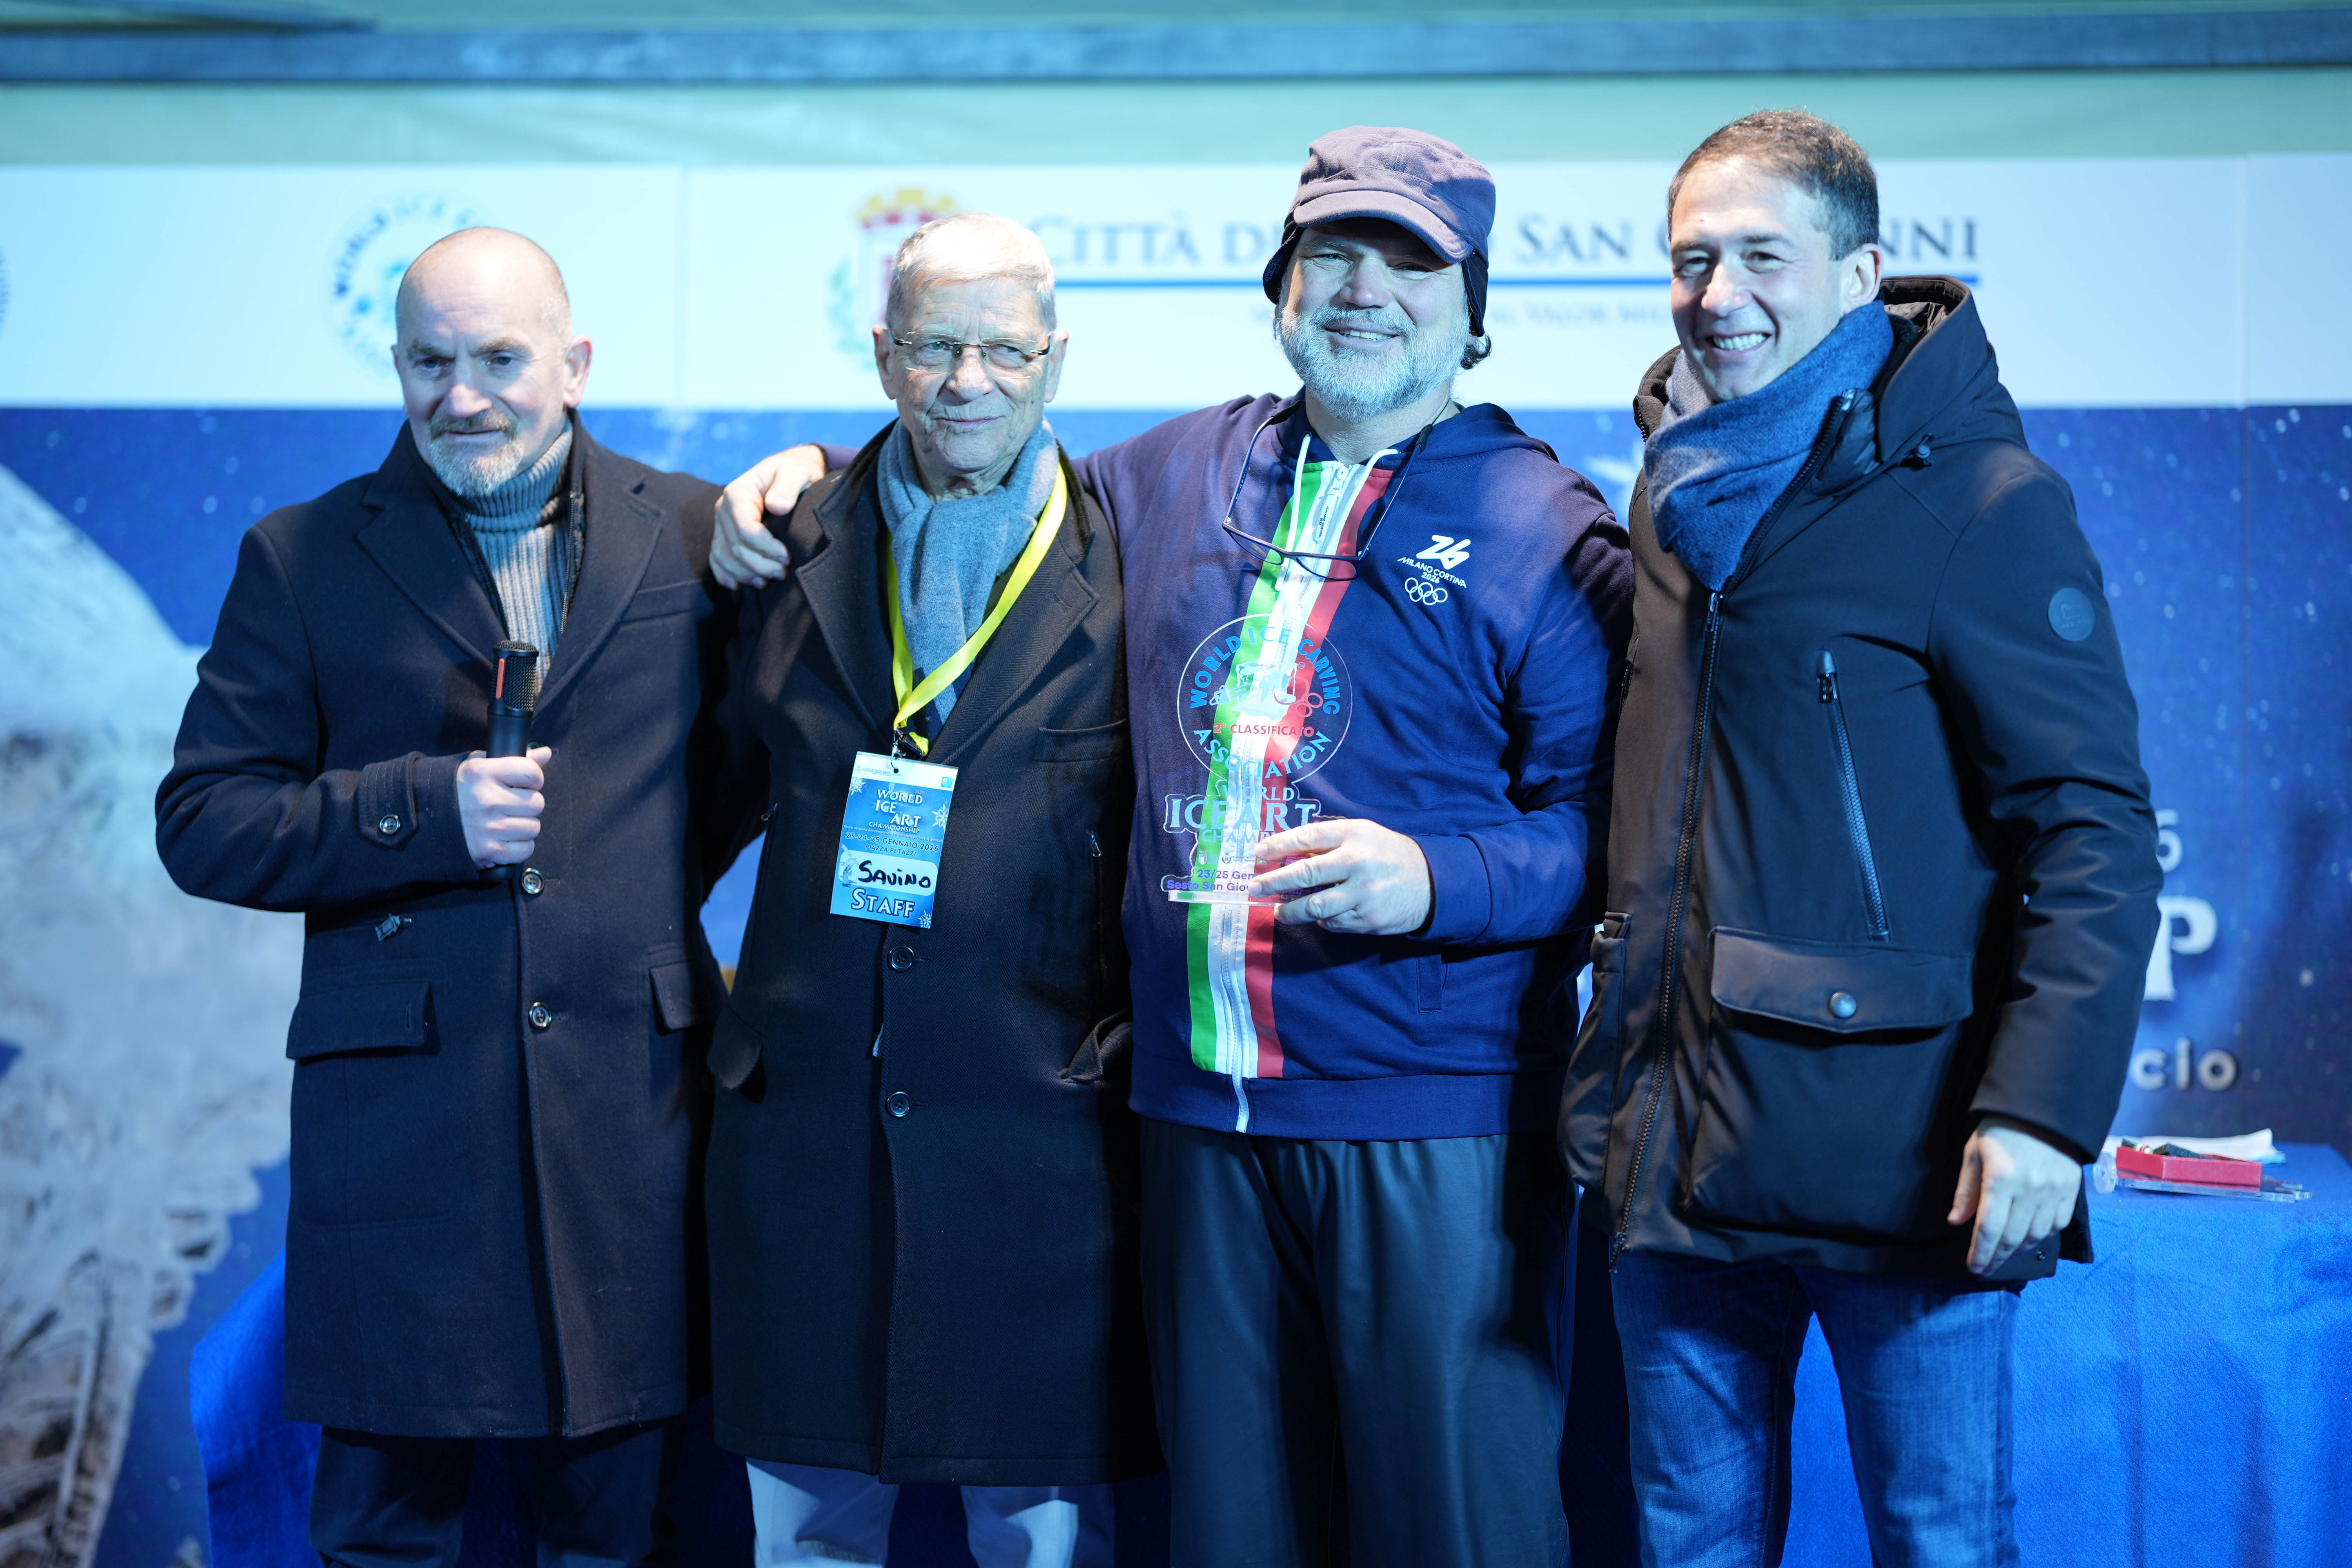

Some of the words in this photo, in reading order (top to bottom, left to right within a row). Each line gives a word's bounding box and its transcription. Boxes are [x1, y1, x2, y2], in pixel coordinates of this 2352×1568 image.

[1515, 215, 1634, 264] SAN
[1397, 557, 1433, 573] MILANO
[1433, 569, 1467, 588] CORTINA
[1421, 572, 1440, 584] 2026
[1190, 636, 1242, 708] WORLD
[1247, 626, 1292, 645] ICE
[1298, 639, 1341, 715] CARVING
[1230, 724, 1314, 737] CLASSIFICATO
[1193, 729, 1332, 779] ASSOCIATION
[877, 789, 923, 804] WORLD
[1223, 785, 1295, 801] WORLD
[875, 800, 898, 814] ICE
[889, 813, 922, 827] ART
[1170, 799, 1229, 830] ICE
[1234, 802, 1317, 831] ART
[868, 821, 920, 834] CHAMPIONSHIP
[846, 831, 880, 843] 23-24-25
[882, 837, 918, 848] GENNAIO
[920, 843, 938, 852] 2026
[865, 844, 888, 852] PIAZZA
[890, 848, 916, 857] PETAZZI
[1197, 869, 1229, 879] 23/25
[1167, 879, 1199, 890] Sesto
[1203, 881, 1223, 891] San
